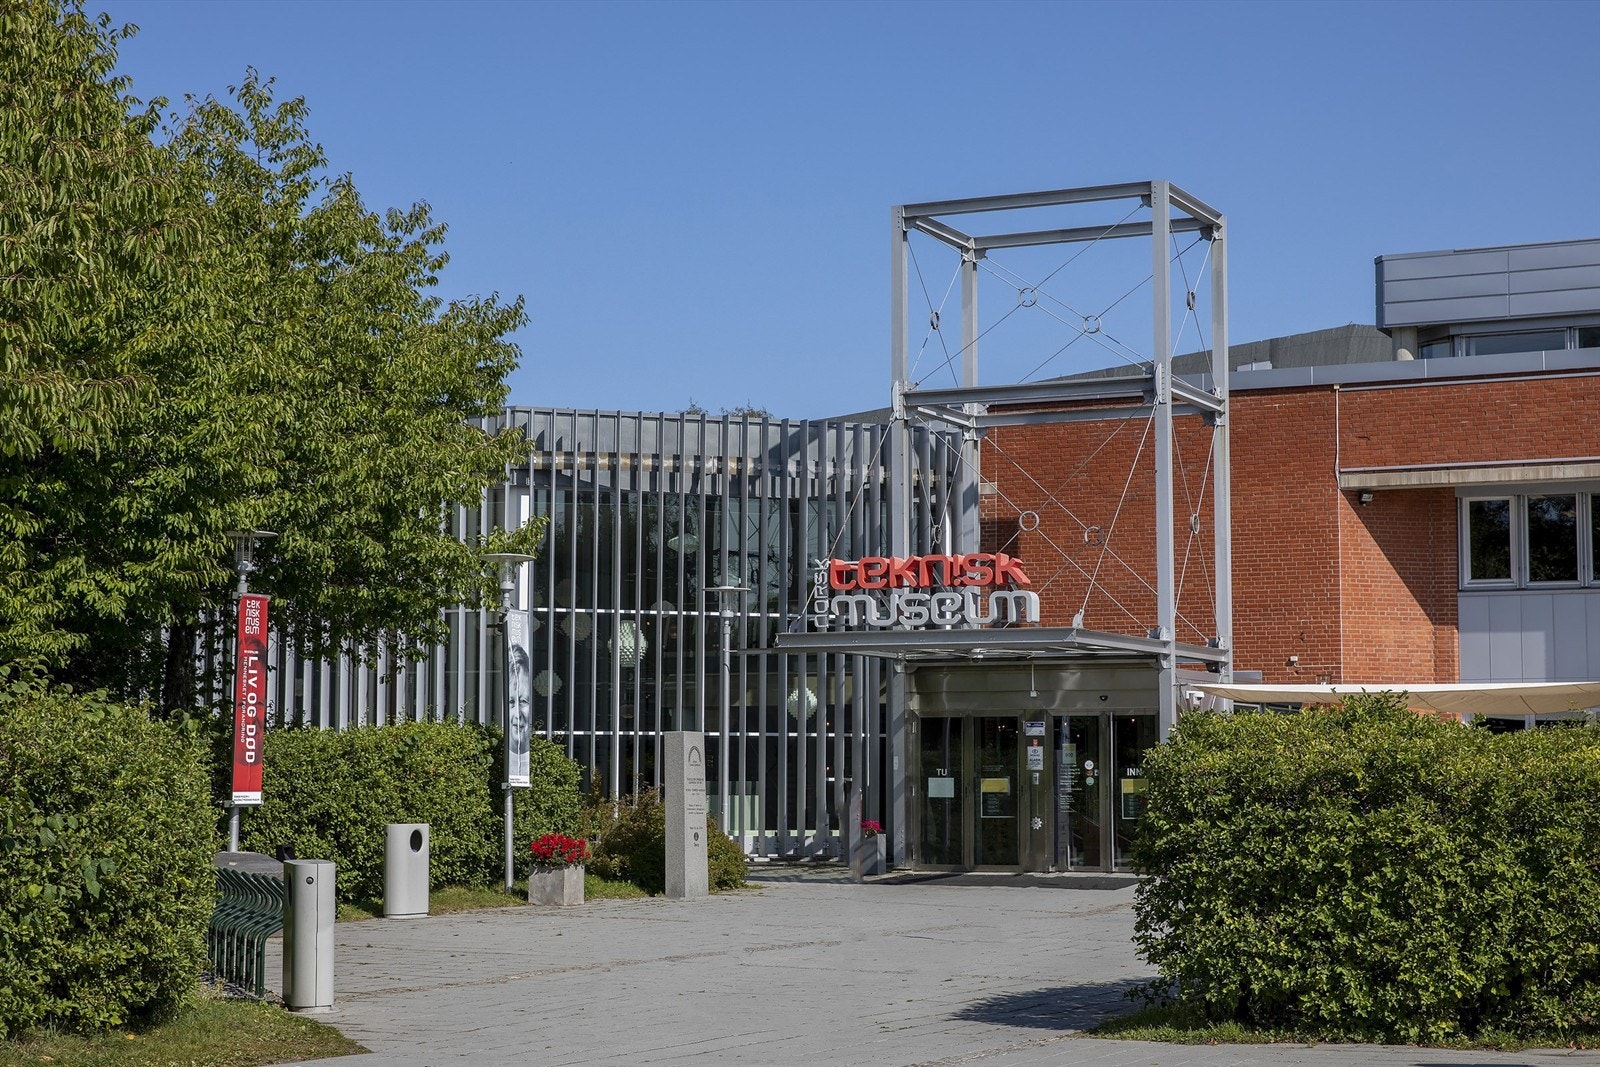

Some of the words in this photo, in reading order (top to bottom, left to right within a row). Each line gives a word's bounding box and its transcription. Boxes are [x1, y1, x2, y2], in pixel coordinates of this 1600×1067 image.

[829, 552, 1031, 590] teknisk
[246, 599, 261, 609] tek
[814, 558, 830, 628] norsk
[245, 608, 260, 617] nisk
[245, 617, 260, 626] mus
[831, 590, 1040, 627] museum
[244, 625, 260, 635] eum
[248, 656, 259, 689] LIV
[246, 692, 257, 718] OG
[245, 724, 256, 763] DØD
[936, 768, 948, 777] TU
